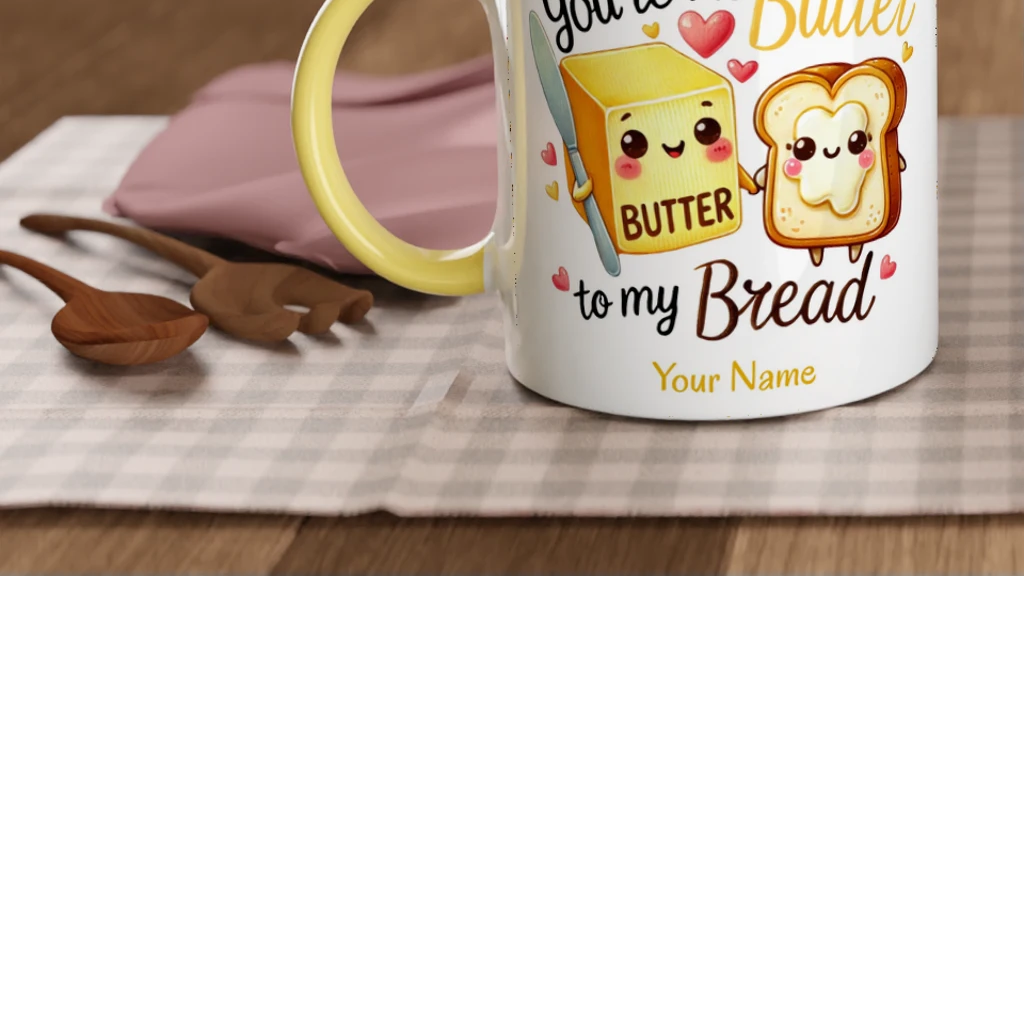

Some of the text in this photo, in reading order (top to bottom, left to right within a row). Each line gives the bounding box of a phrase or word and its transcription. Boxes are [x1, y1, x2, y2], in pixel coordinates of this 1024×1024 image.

[621, 187, 734, 241] BUTTER
[573, 251, 876, 341] to my Bread
[652, 360, 817, 393] Your Name
